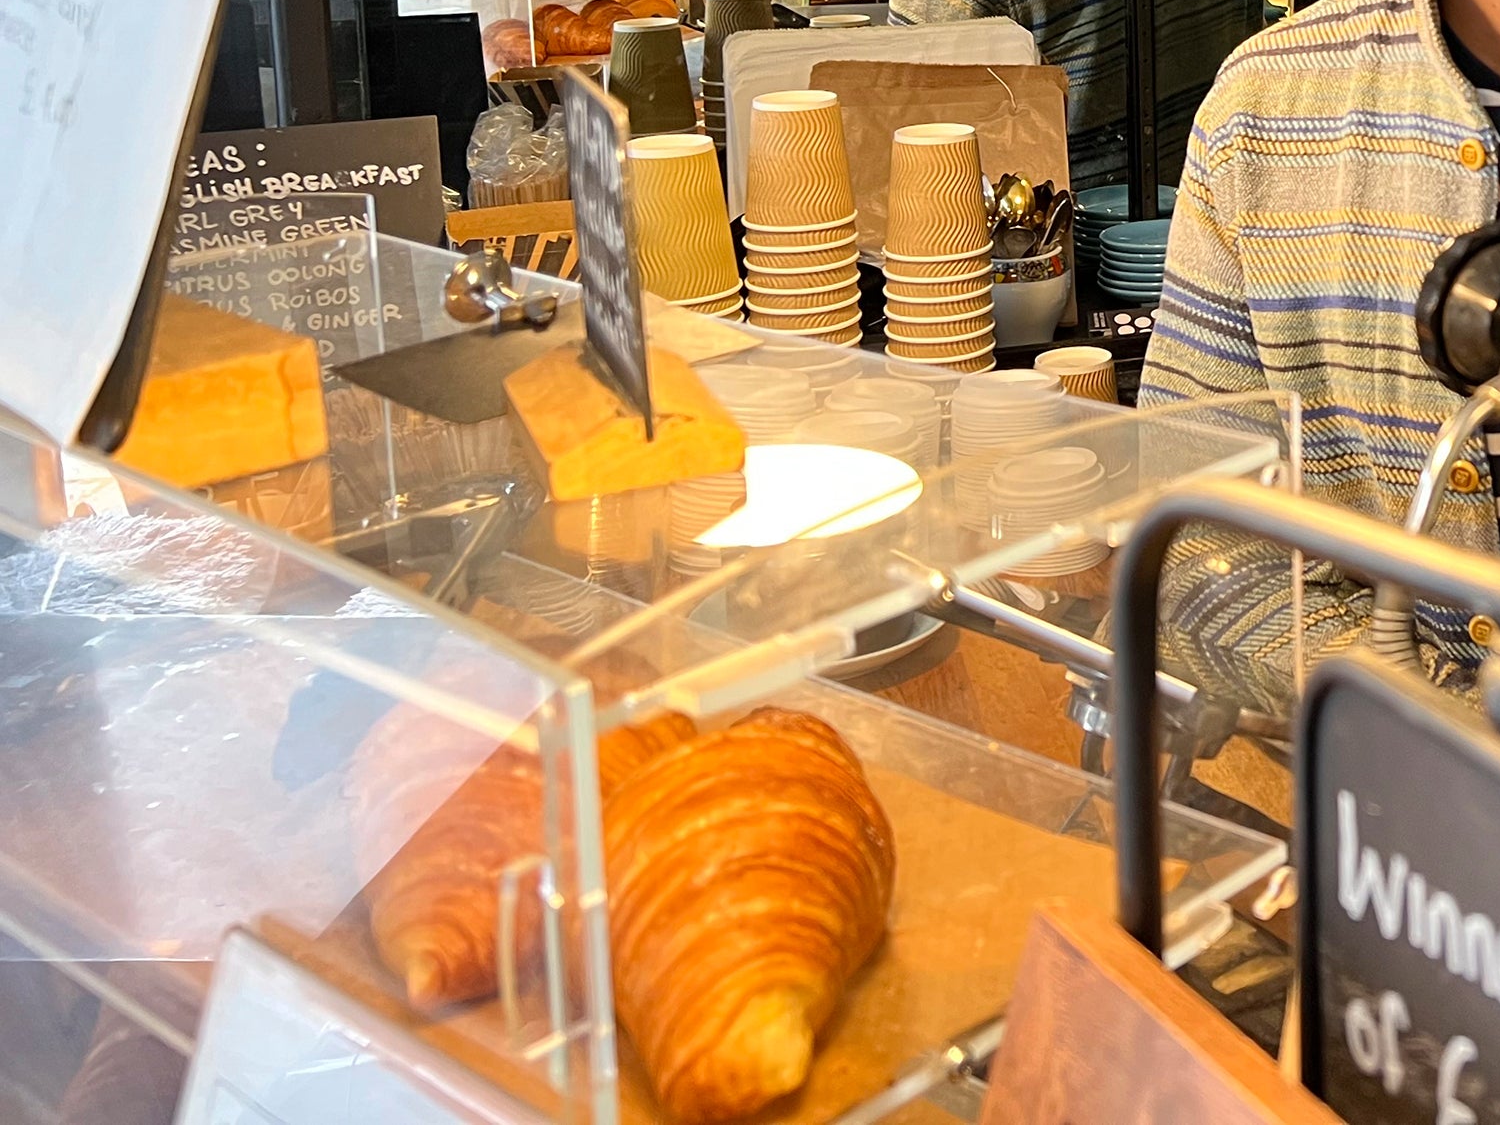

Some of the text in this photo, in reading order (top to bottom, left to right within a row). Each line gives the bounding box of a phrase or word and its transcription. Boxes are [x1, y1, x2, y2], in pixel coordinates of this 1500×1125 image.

[174, 202, 303, 234] RL GREY
[280, 212, 371, 242] GREEN
[268, 257, 365, 286] OOLONG
[307, 303, 403, 331] GINGER
[1345, 990, 1411, 1095] of
